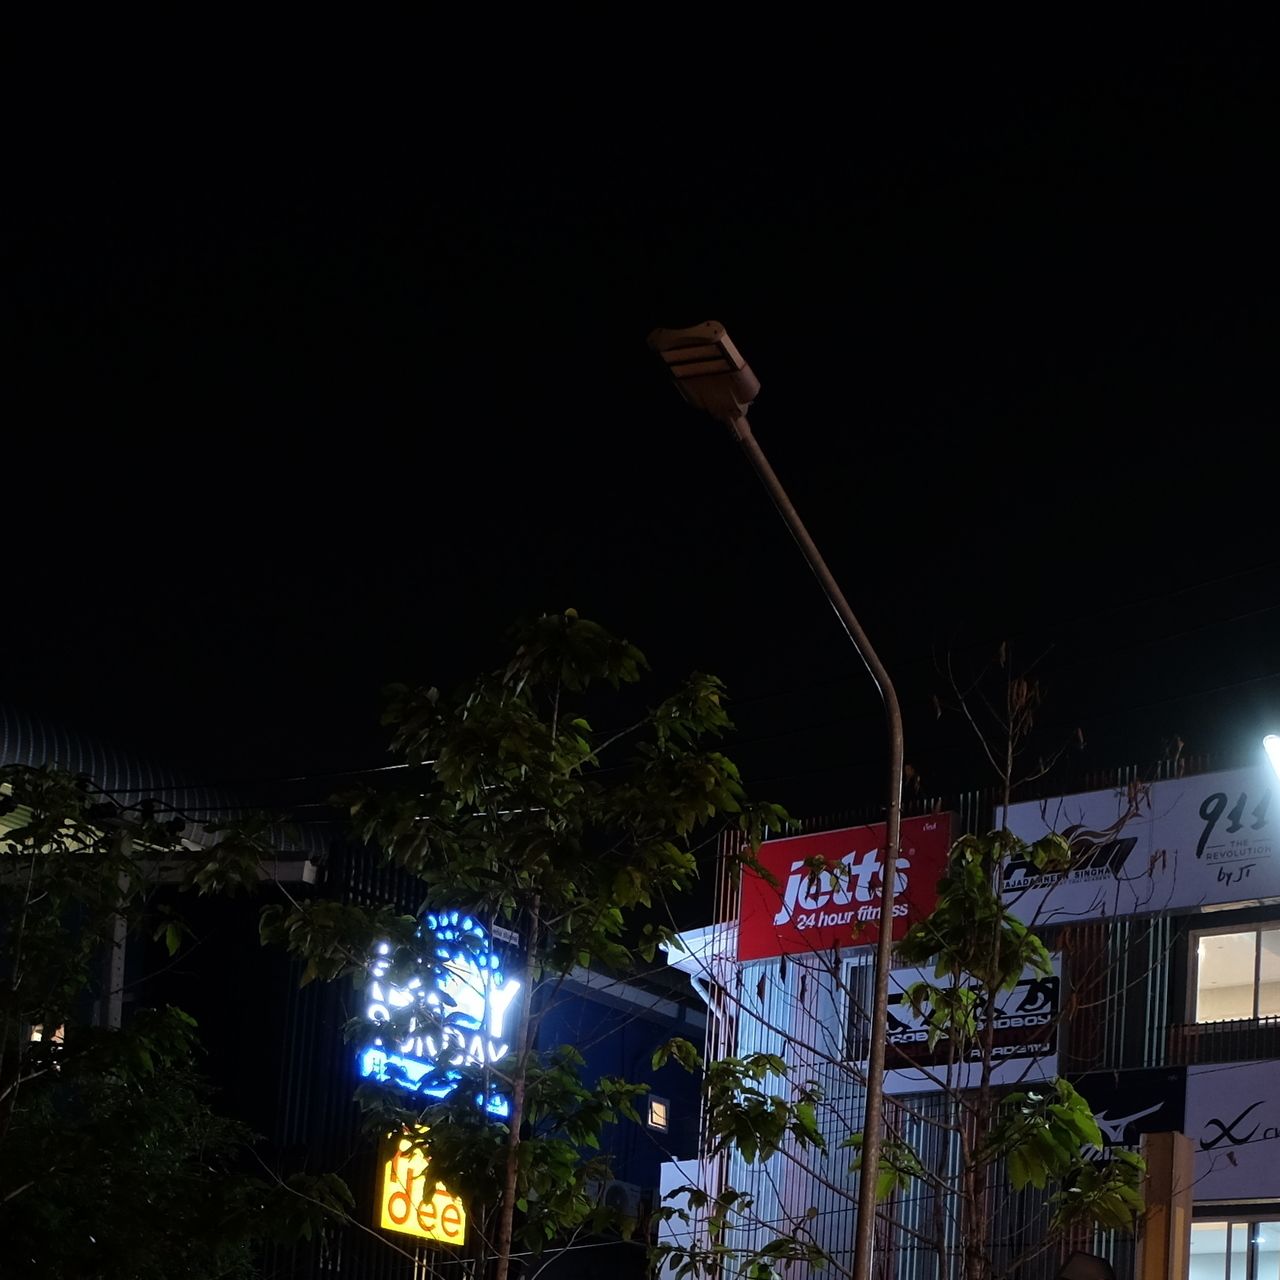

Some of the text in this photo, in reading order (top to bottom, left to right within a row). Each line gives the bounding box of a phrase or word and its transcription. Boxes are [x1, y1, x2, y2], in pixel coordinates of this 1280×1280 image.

[1229, 839, 1249, 848] THE
[1206, 846, 1272, 861] REVOLUTION
[1217, 866, 1233, 887] by
[796, 903, 909, 930] 24 hour fitnss
